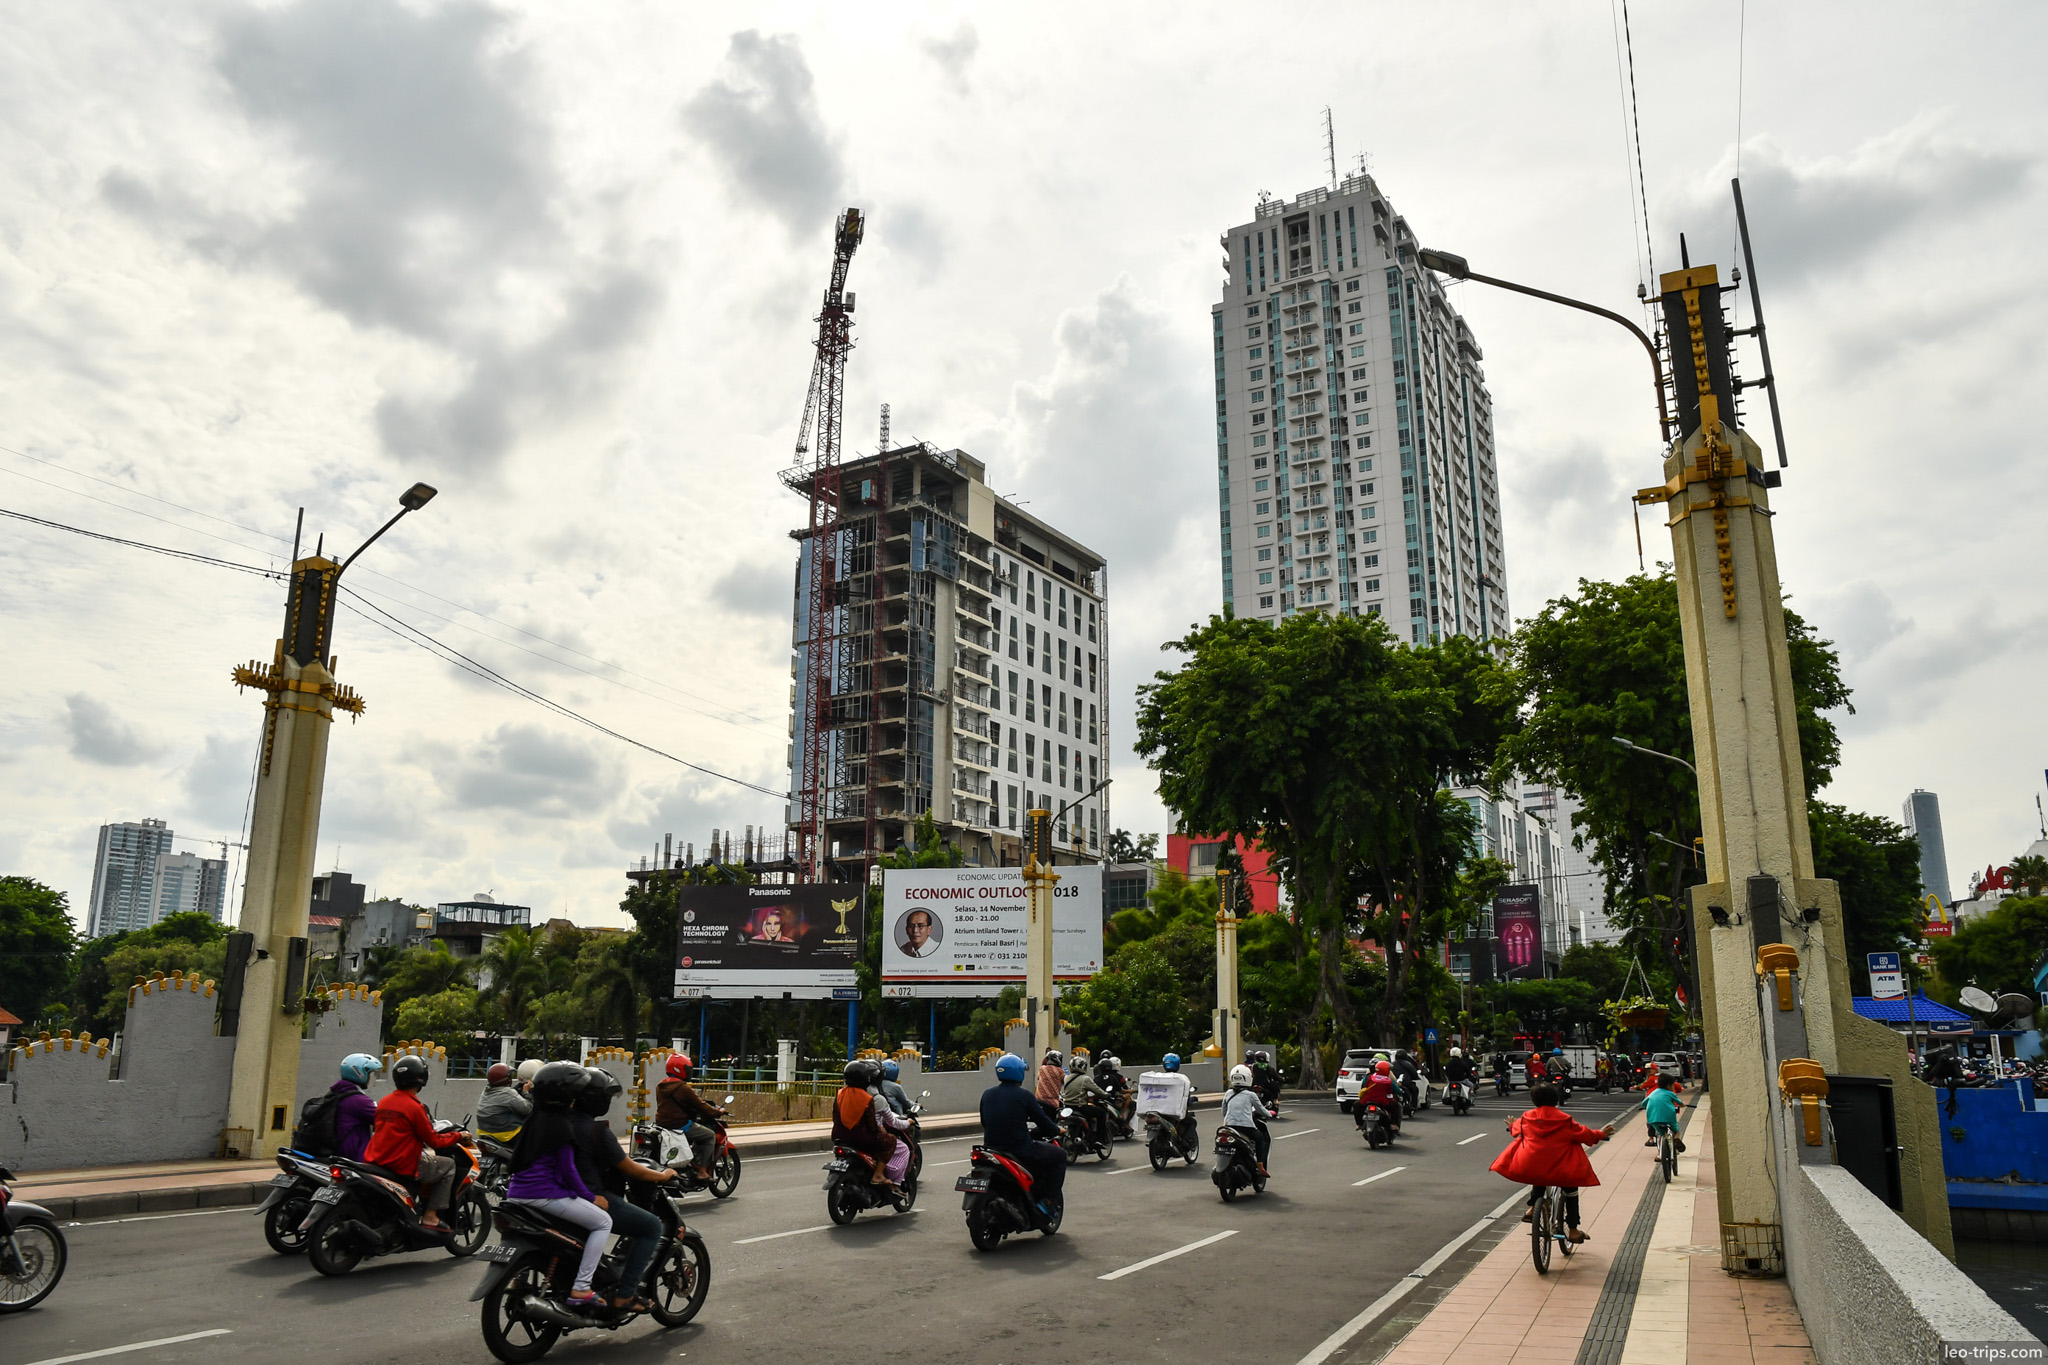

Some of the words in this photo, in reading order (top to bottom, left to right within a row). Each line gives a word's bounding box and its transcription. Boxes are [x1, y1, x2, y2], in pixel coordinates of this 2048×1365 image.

[817, 767, 825, 842] SAFETY
[957, 873, 996, 881] ECONOMIC
[749, 887, 792, 896] Panasonic
[905, 887, 974, 900] ECONOMIC
[1053, 885, 1079, 898] 018
[954, 905, 978, 913] Selasa,
[688, 988, 700, 996] 077
[898, 987, 912, 996] 072
